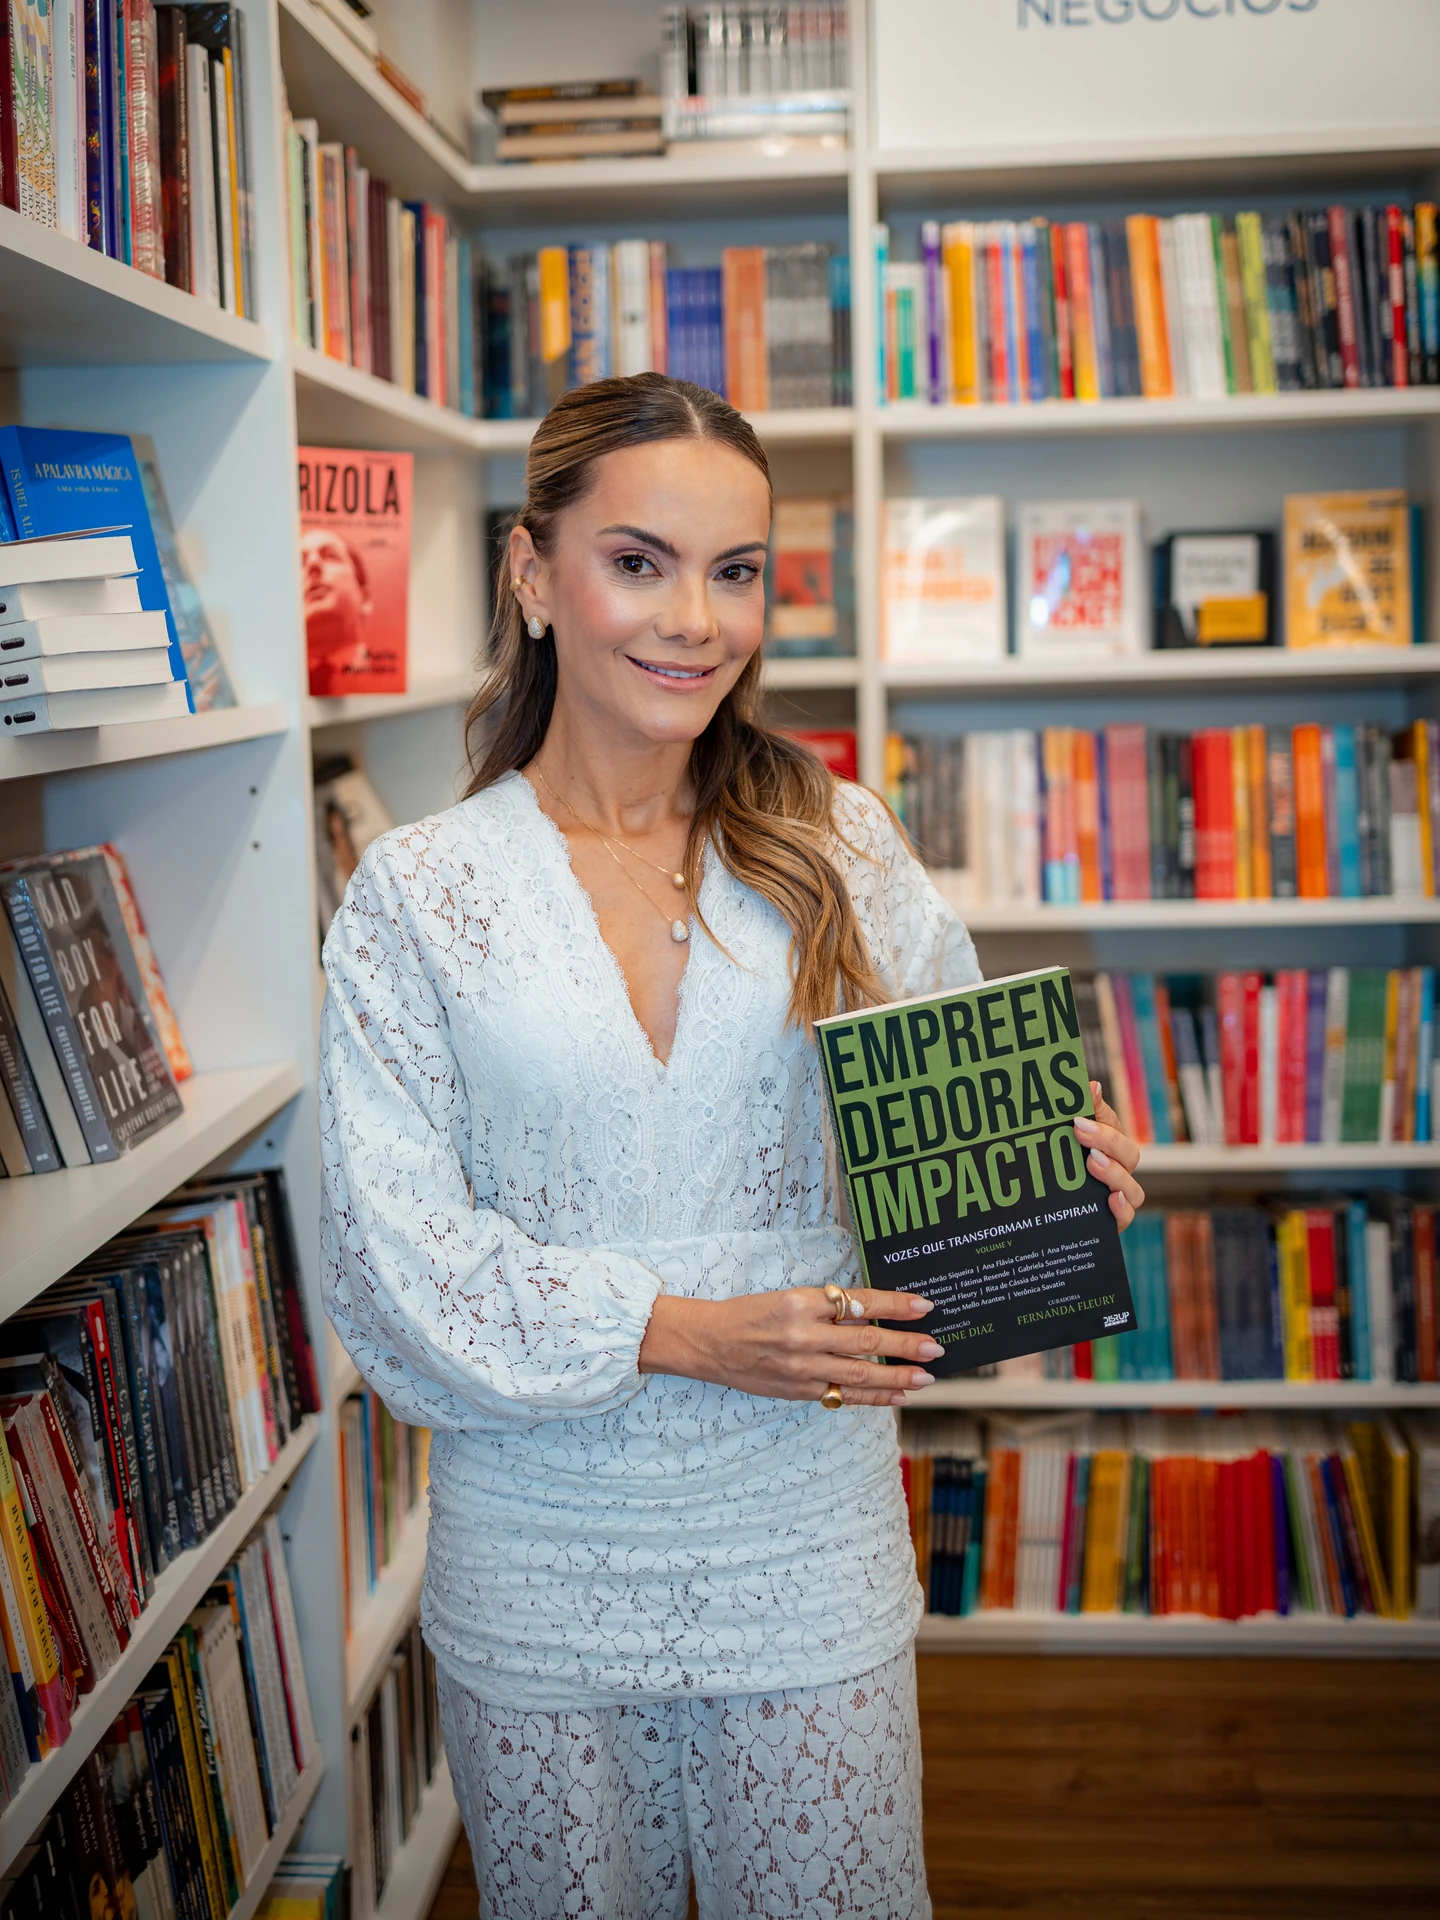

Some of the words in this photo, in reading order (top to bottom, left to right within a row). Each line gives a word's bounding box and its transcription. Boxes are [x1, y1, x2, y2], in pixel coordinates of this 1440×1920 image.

[1018, 0, 1318, 28] NEGO
[35, 462, 41, 478] A
[43, 463, 91, 480] PALAVRA
[92, 463, 132, 482] MÁGICA
[10, 467, 28, 512] ISABEL
[22, 513, 34, 538] ALL
[9, 894, 30, 924] BAD
[36, 877, 82, 930] BAD
[19, 926, 40, 953] BOY
[29, 955, 51, 984] FOR
[56, 938, 101, 993] BOY
[39, 982, 62, 1017] LIFE
[77, 1000, 123, 1057] FOR
[825, 974, 1081, 1094] EMPREEN
[99, 1058, 148, 1119] LIFE
[840, 1051, 1085, 1168] DEDORAS
[853, 1125, 1087, 1242] IMPACTO
[884, 1247, 920, 1264] VOZES
[922, 1240, 946, 1254] QUE
[947, 1220, 1033, 1248] TRANSFORMAM
[1035, 1216, 1043, 1226] E
[1044, 1203, 1099, 1224] INSPIRAM
[975, 1241, 1006, 1255] VOLUME
[895, 1284, 908, 1292] Ana
[909, 1277, 928, 1289] Flávia
[928, 1273, 948, 1284] Abrão
[948, 1267, 974, 1281] Siqueira
[982, 1262, 995, 1271] Ana
[996, 1256, 1014, 1268] Flávia
[1015, 1252, 1039, 1263] Canedo
[1047, 1245, 1060, 1255] Ana
[1061, 1241, 1079, 1252] Paula
[1079, 1237, 1100, 1248] Garcia
[930, 1285, 953, 1296] Batista
[960, 1278, 983, 1288] Fátima
[983, 1270, 1010, 1282] Resende
[1018, 1262, 1045, 1274] Gabriela
[1045, 1257, 1067, 1267] Soares
[1067, 1251, 1093, 1262] Pedroso
[935, 1295, 957, 1307] Dayrell
[957, 1289, 978, 1301] Fleury
[985, 1283, 998, 1293] Rita
[1000, 1282, 1008, 1290] de
[1009, 1276, 1029, 1288] Cássia
[1030, 1274, 1039, 1282] do
[1039, 1270, 1056, 1280] Valle
[1056, 1266, 1072, 1276] Faria
[1073, 1261, 1096, 1272] Cascão
[942, 1303, 962, 1316] Thays
[962, 1300, 980, 1311] Mello
[981, 1293, 1006, 1305] Arantes
[1013, 1286, 1041, 1298] Verônica
[1041, 1280, 1066, 1291] Savatin
[1017, 1304, 1076, 1325] FERNANDA
[1077, 1293, 1116, 1312] FLEURY
[1048, 1294, 1081, 1306] CURADORIA
[931, 1320, 971, 1334] ORGANIZAÇÃO
[969, 1323, 995, 1337] DIAZ
[101, 1361, 112, 1399] NOITE
[119, 1389, 128, 1408] C.
[53, 1394, 67, 1429] GRACIE
[109, 1405, 116, 1420] DA
[121, 1412, 130, 1430] S.
[65, 1429, 81, 1467] RICKSON
[113, 1426, 129, 1501] ENFERMEIRO
[141, 1411, 157, 1473] LEWIS
[125, 1434, 140, 1498] LEWIS
[12, 1504, 24, 1545] AMAR
[73, 1488, 94, 1547] ferozes
[22, 1550, 39, 1608] REZAR
[92, 1545, 111, 1595] Afetos
[37, 1615, 53, 1669] COMER
[73, 1790, 81, 1811] DA
[79, 1815, 91, 1855] VINCI
[79, 1776, 99, 1850] LEONARDO
